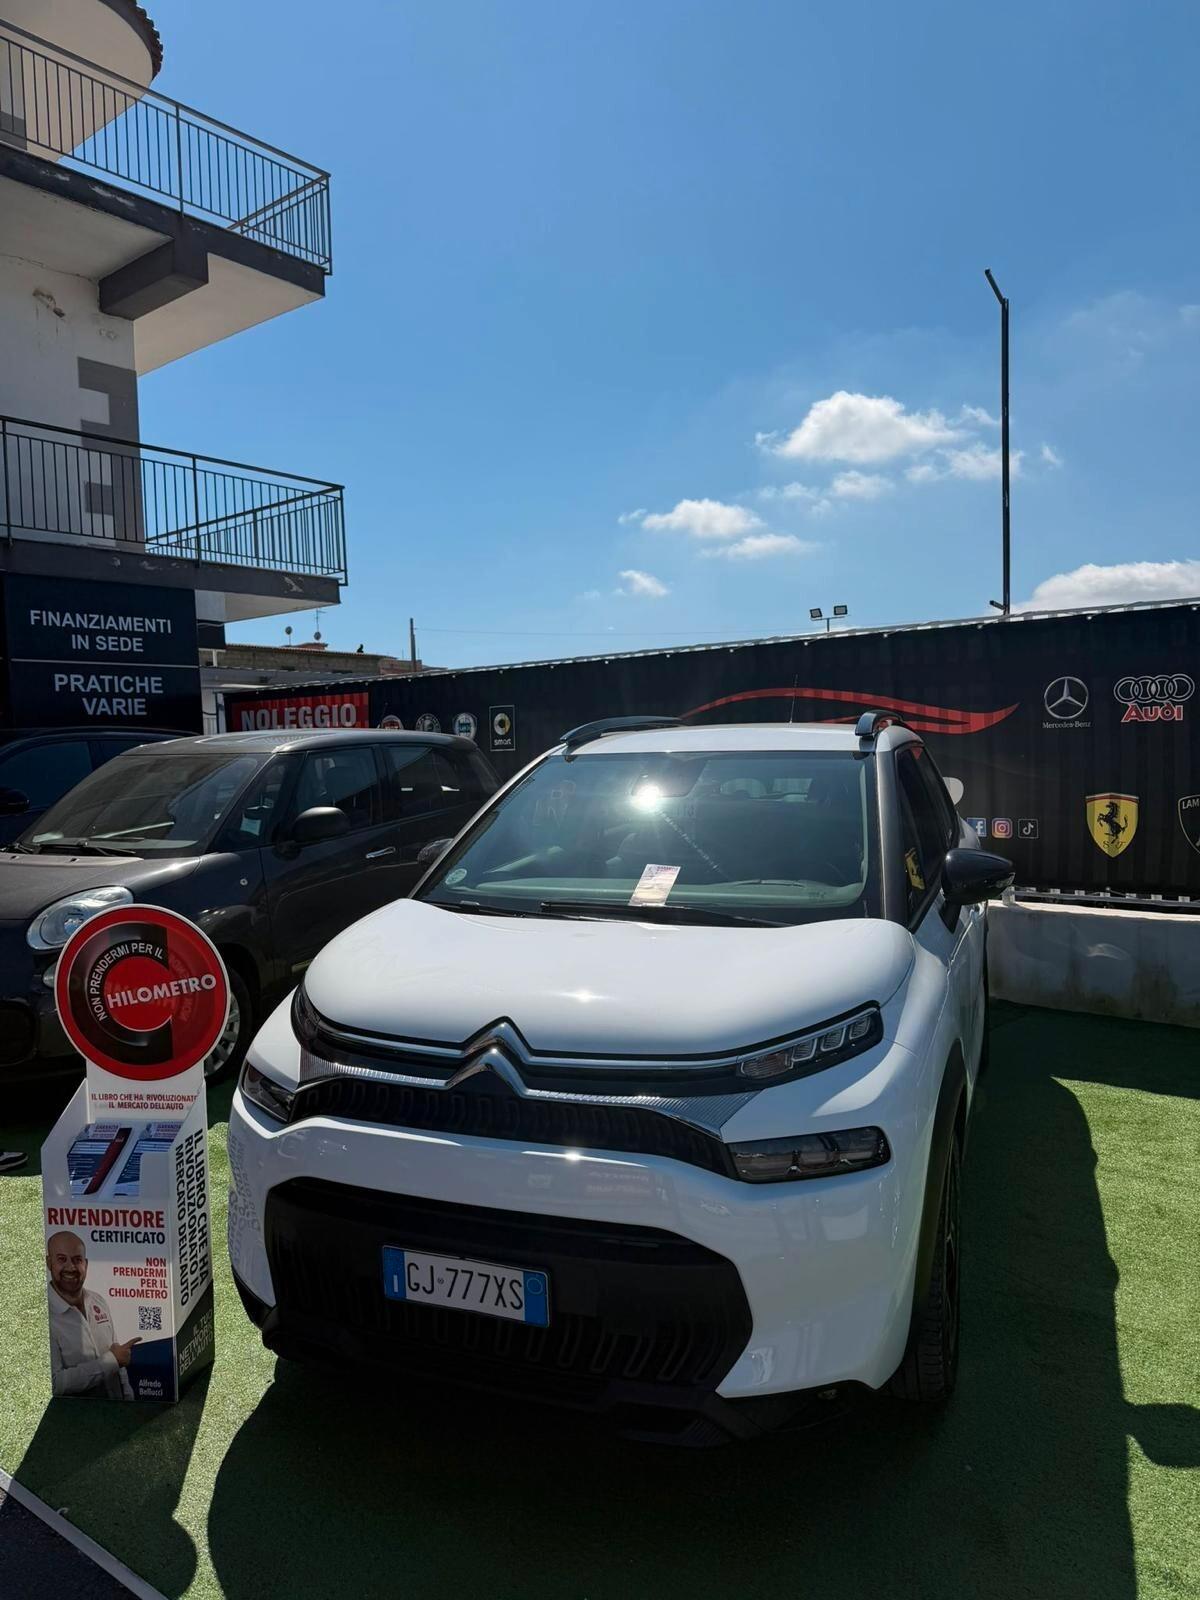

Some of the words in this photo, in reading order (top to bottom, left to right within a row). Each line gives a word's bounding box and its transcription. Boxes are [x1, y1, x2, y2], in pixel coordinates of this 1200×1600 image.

[30, 610, 172, 633] FINANZIAMENTI
[71, 634, 89, 650] IN
[96, 636, 144, 652] SEDE
[54, 674, 164, 694] PRATICHE
[82, 698, 147, 716] VARIE
[241, 703, 357, 731] NOLEGGIO
[1042, 720, 1091, 729] Mercedes-Benz
[493, 738, 512, 746] smart
[131, 943, 153, 955] PER
[154, 946, 164, 959] IL
[90, 944, 130, 995] PRENDERMI
[93, 998, 108, 1021] NON
[98, 1093, 118, 1101] LIBRO
[117, 1102, 149, 1110] MERCATO
[193, 1129, 203, 1149] IL
[175, 1144, 187, 1220] MERCATO
[194, 1150, 207, 1209] LIBRO
[184, 1134, 199, 1275] RIVOLUZIONATO
[47, 1207, 165, 1228] RIVENDITORE
[90, 1230, 165, 1244] CERTIFICATO
[197, 1213, 208, 1252] CHE
[145, 1257, 166, 1267] NON
[178, 1224, 190, 1306] DELL'AUTO
[199, 1254, 209, 1285] HA
[113, 1267, 167, 1278] PRENDERMI
[140, 1278, 158, 1288] PER
[160, 1279, 168, 1288] IL
[190, 1277, 199, 1296] IL
[109, 1287, 168, 1299] CHILOMETRO
[139, 1379, 161, 1388] Alfredo
[139, 1388, 163, 1397] Bellucci
